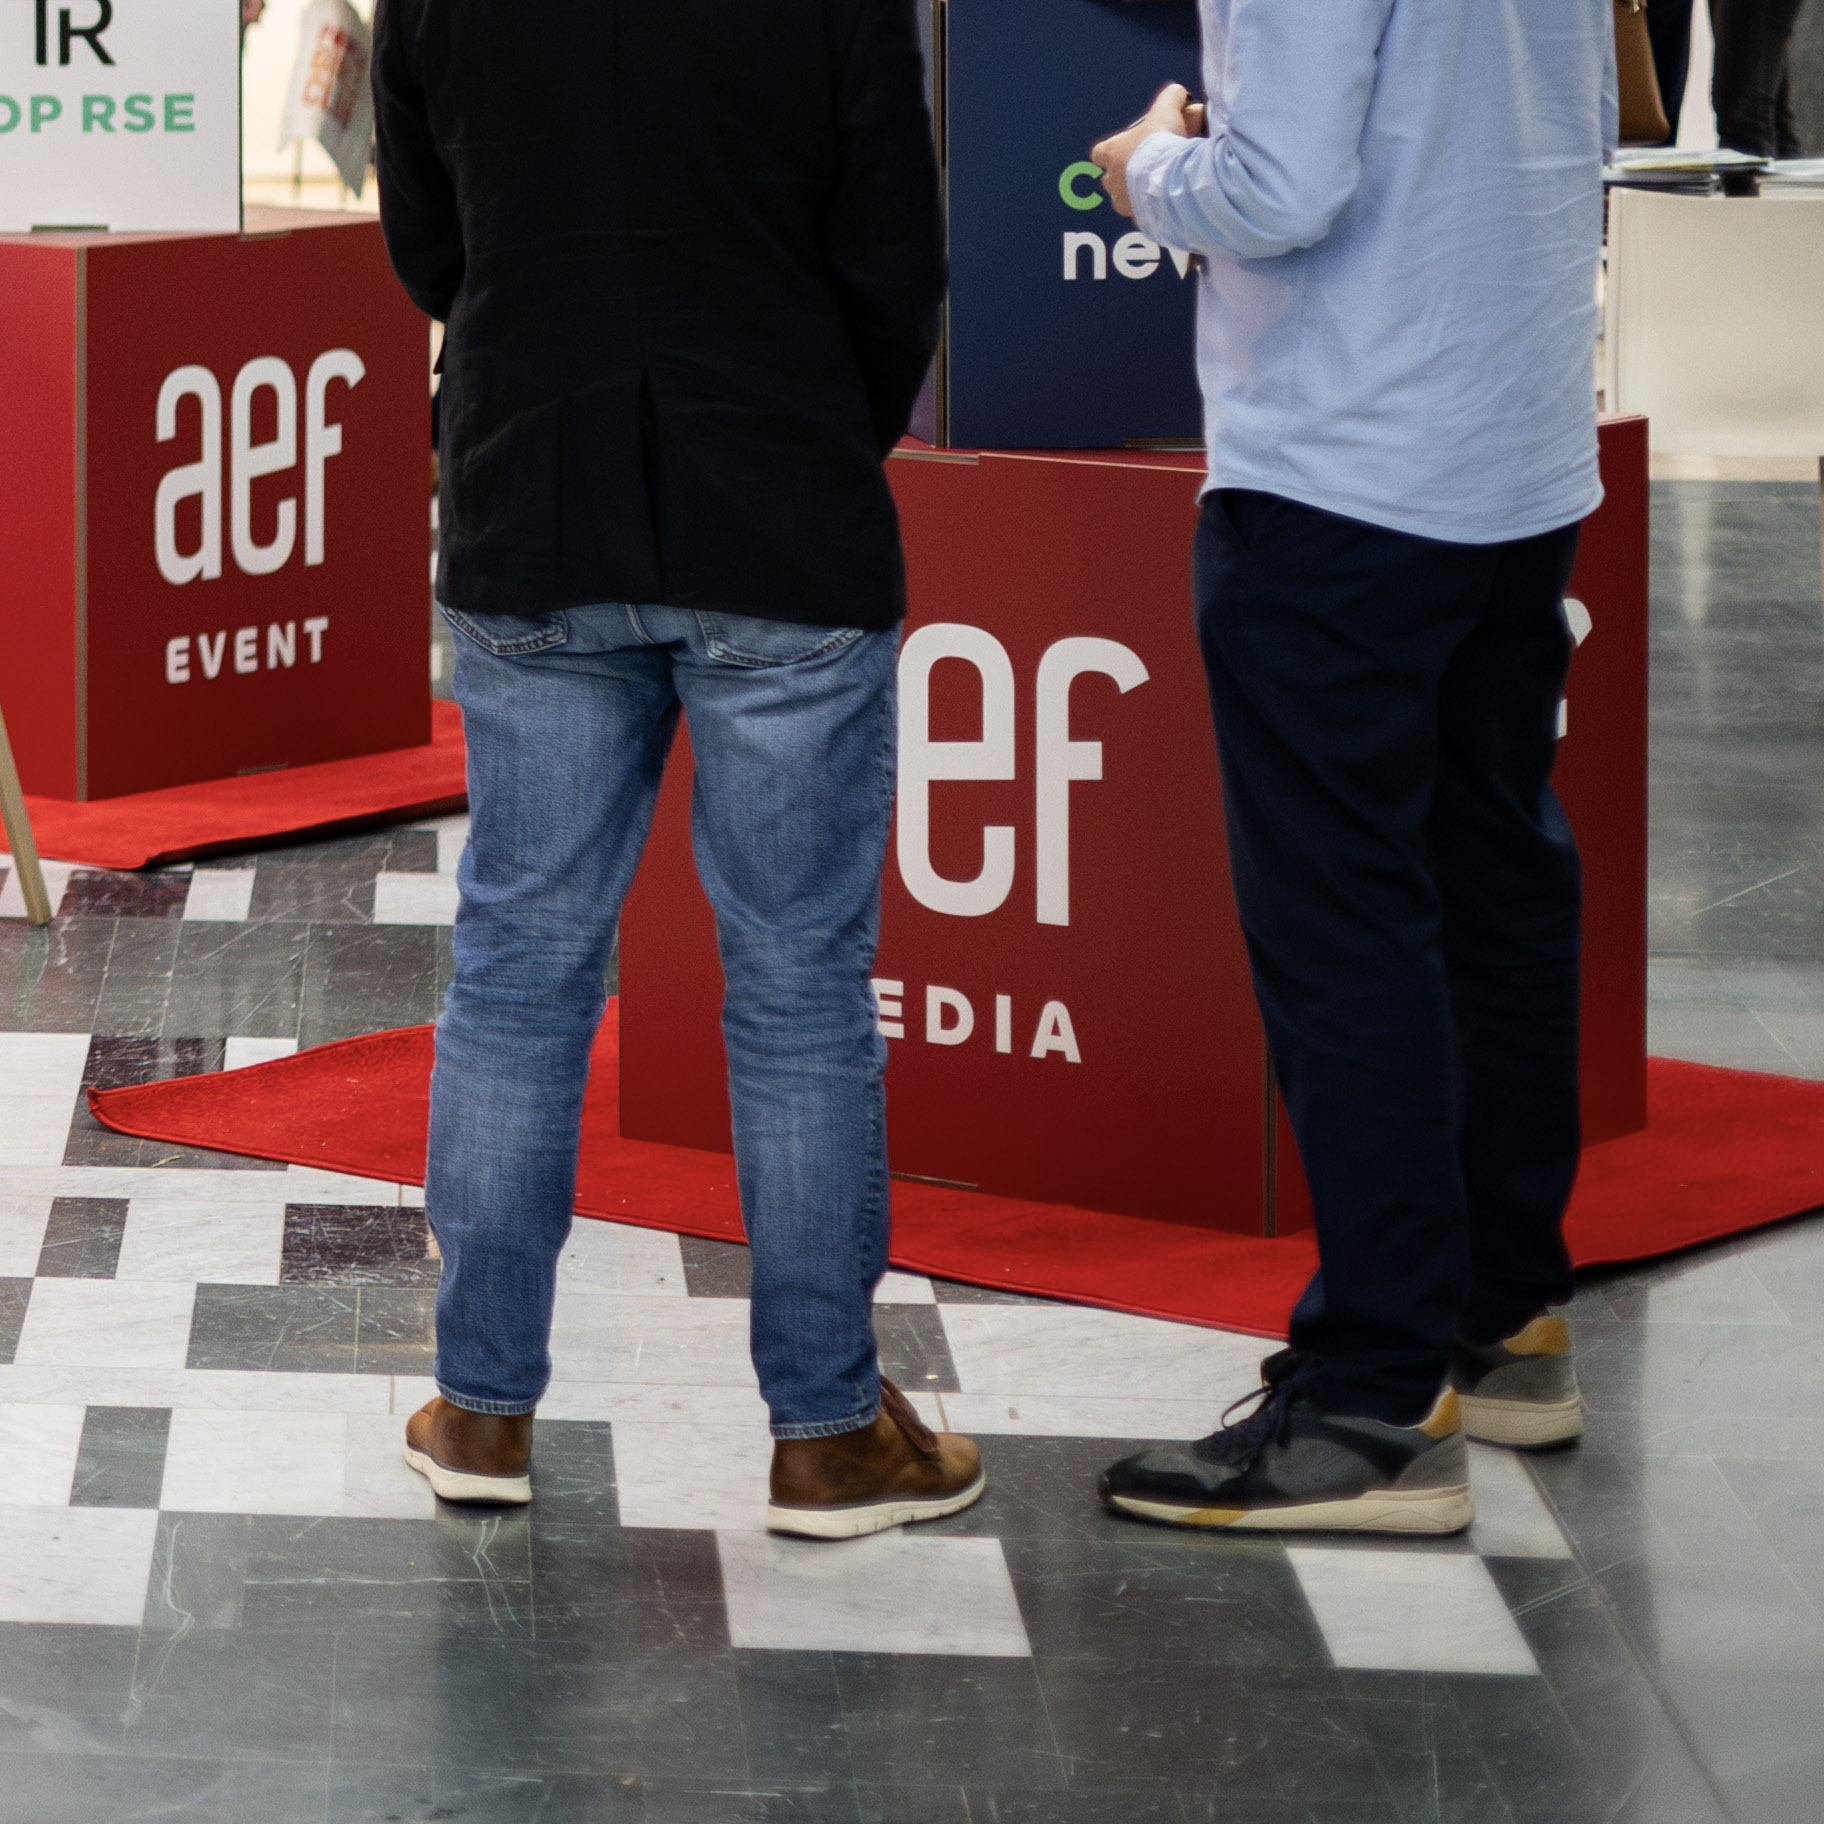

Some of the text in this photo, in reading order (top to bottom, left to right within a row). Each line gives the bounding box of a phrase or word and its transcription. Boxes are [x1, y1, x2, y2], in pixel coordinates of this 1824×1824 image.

[81, 92, 197, 134] RSE
[155, 348, 366, 585] aef
[166, 616, 329, 684] EVENT
[897, 622, 1151, 927] ef
[870, 977, 1082, 1064] EDIA
